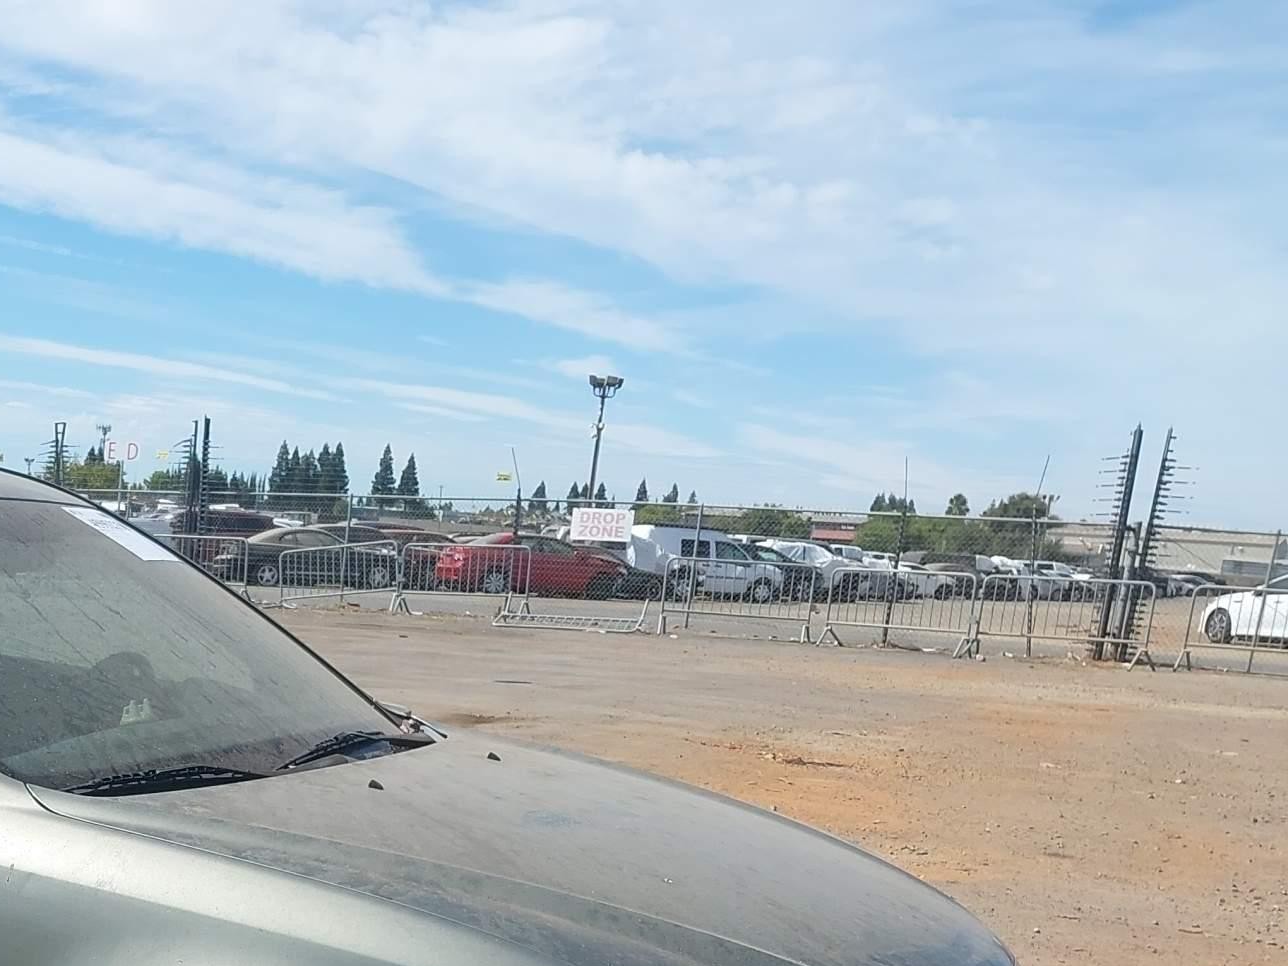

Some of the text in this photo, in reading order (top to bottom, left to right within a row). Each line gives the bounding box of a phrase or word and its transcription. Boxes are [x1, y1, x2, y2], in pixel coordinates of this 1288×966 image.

[108, 441, 139, 460] E D
[580, 511, 627, 525] DROP
[577, 525, 625, 538] ZONE
